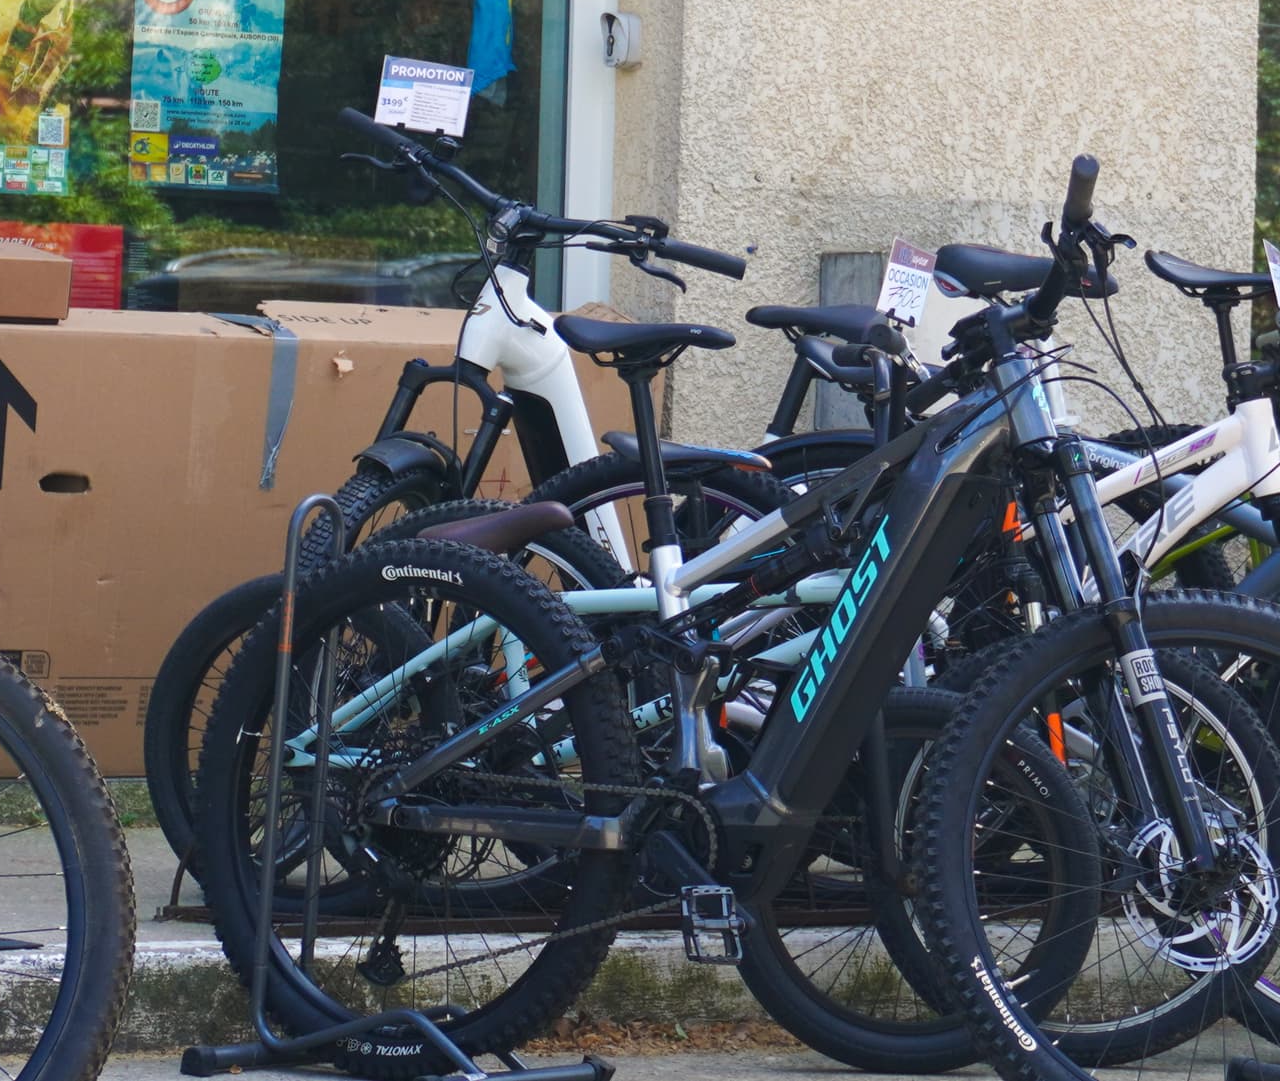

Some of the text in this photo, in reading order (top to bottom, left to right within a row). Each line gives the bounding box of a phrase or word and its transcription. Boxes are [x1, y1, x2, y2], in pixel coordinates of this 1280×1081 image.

[240, 33, 266, 41] AUBORD
[391, 64, 465, 82] PROMOTION
[163, 96, 175, 104] 75
[181, 142, 216, 150] DECATHLON
[888, 268, 929, 290] OCCASION
[277, 313, 336, 325] SIDE
[381, 564, 454, 583] Continental
[789, 514, 892, 724] GHOST
[974, 969, 1039, 1052] Continental
[374, 1042, 423, 1057] XYNOTAL
